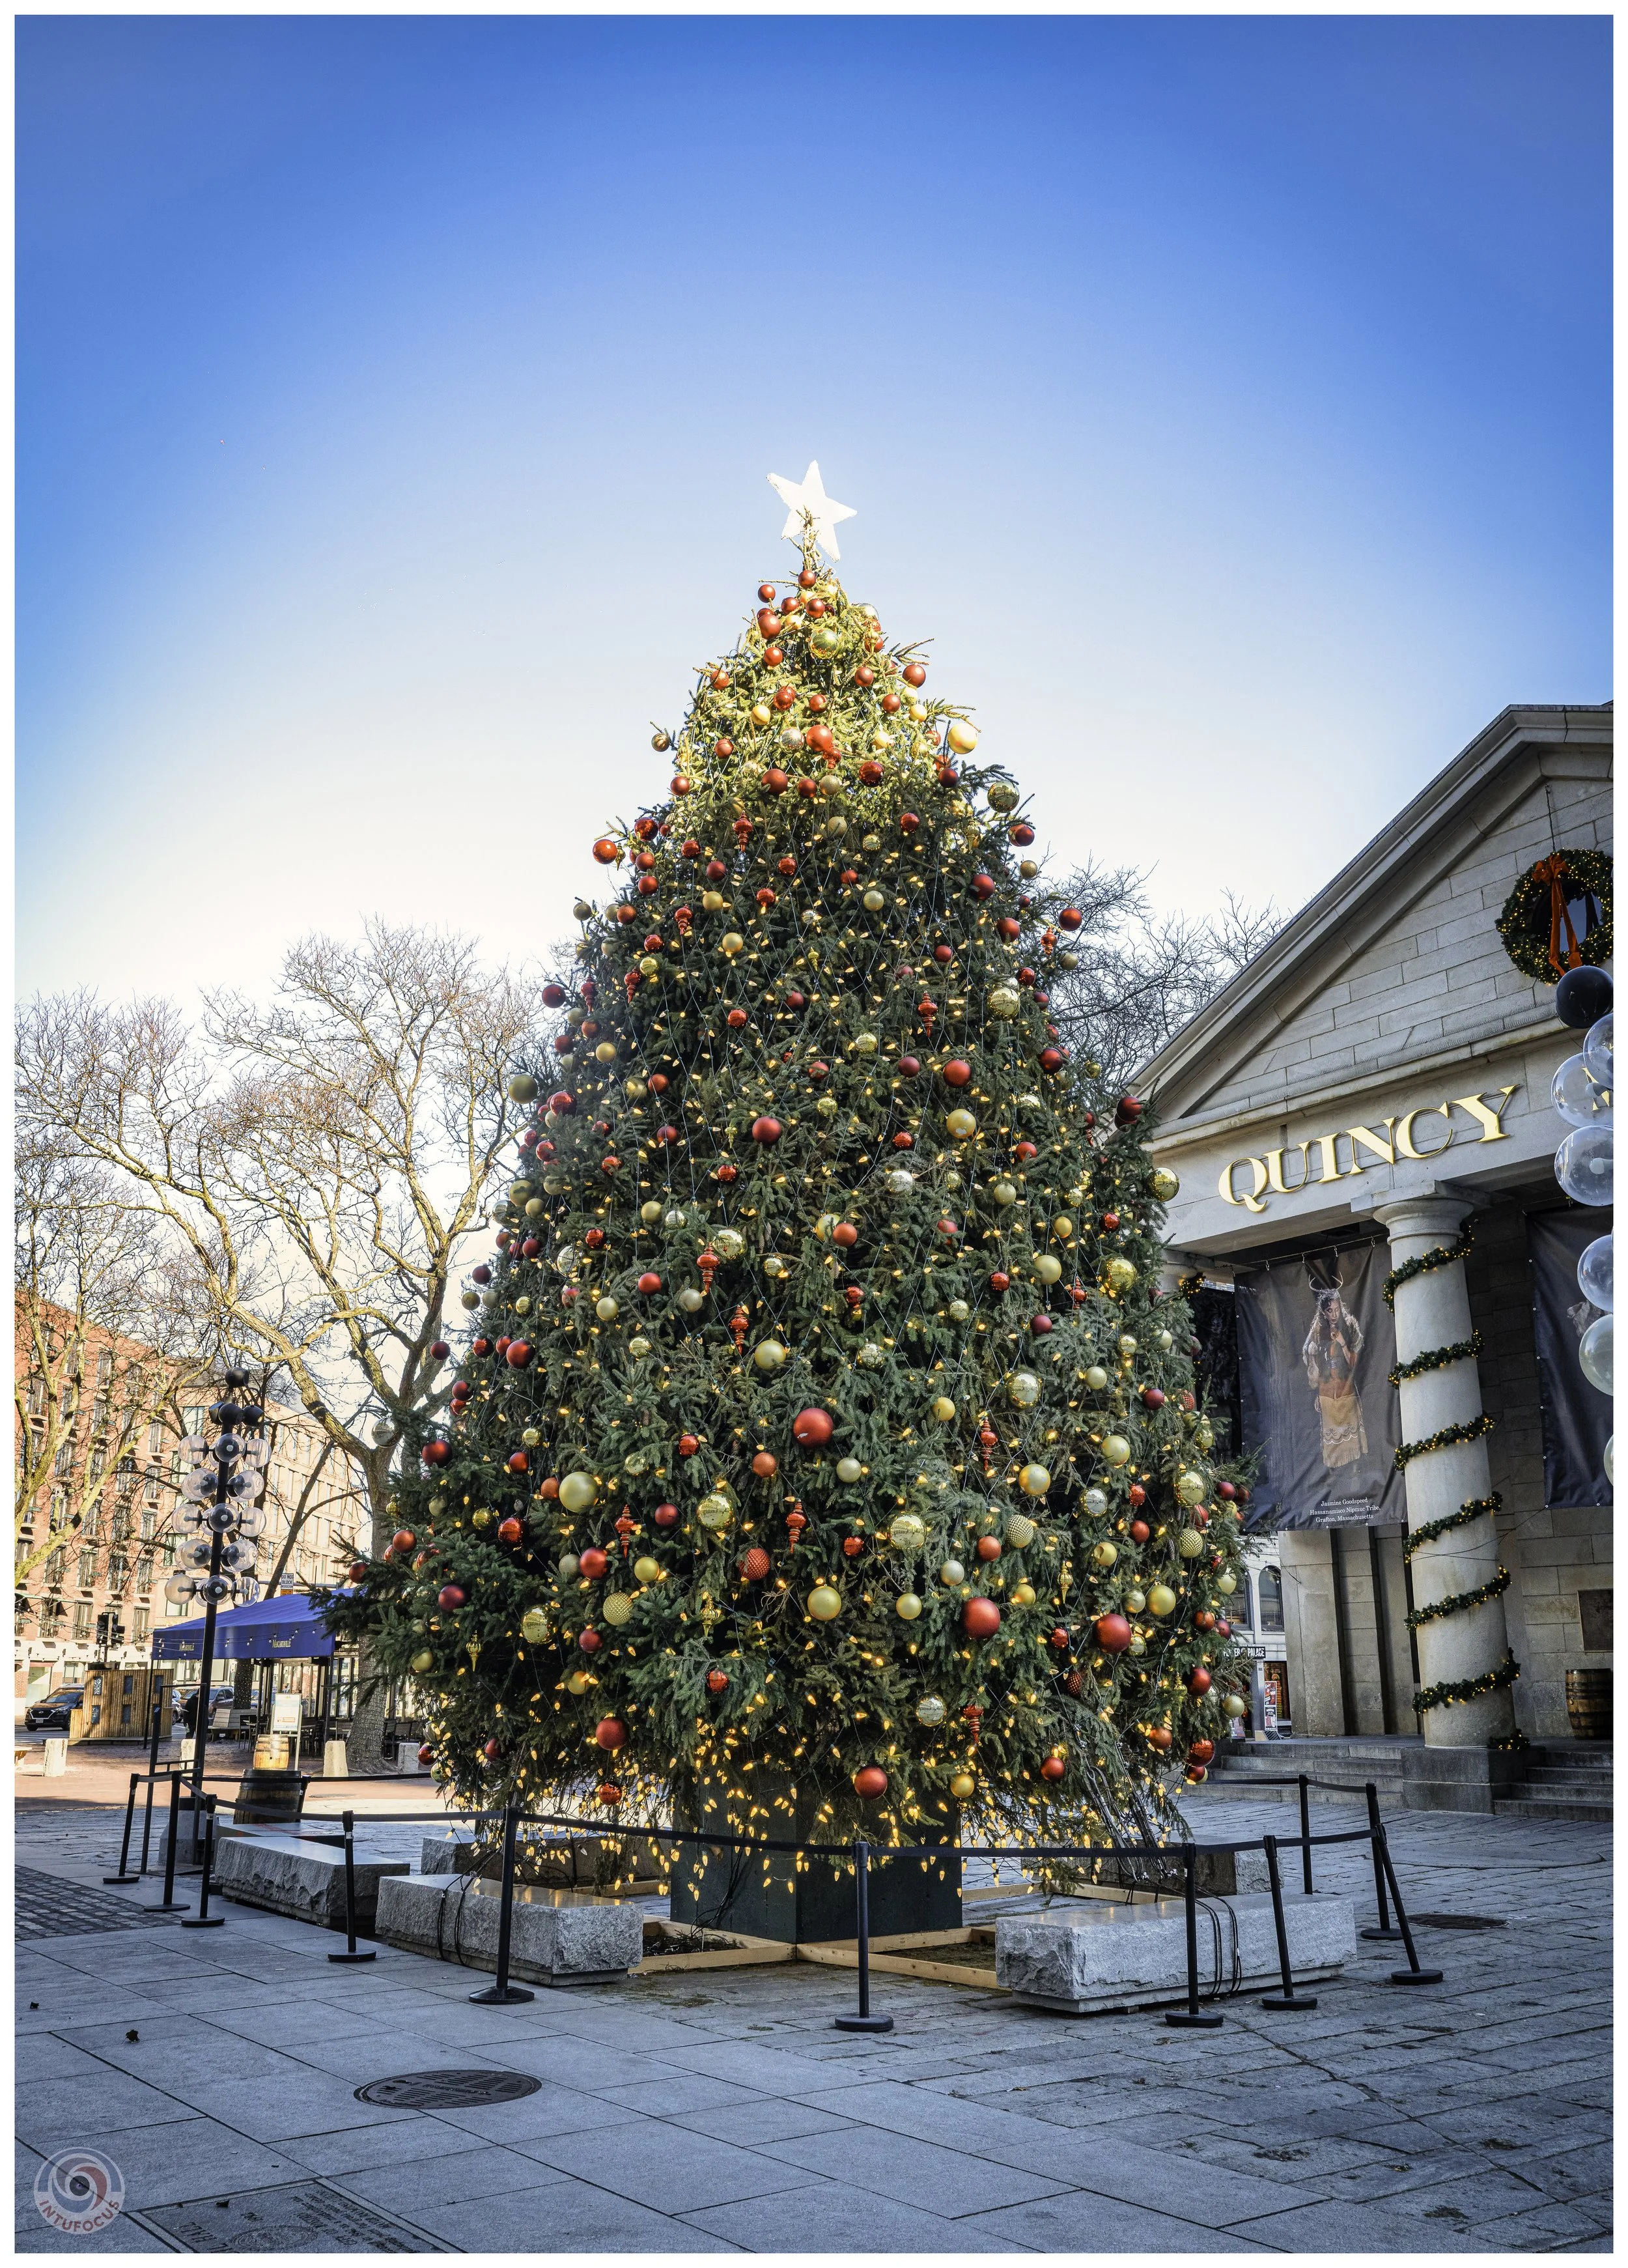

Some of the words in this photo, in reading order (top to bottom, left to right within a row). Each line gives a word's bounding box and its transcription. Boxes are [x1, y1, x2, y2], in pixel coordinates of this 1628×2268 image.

[1218, 1084, 1519, 1213] QUINCY
[1247, 1648, 1265, 1656] PALACE
[171, 2221, 218, 2243] HALL
